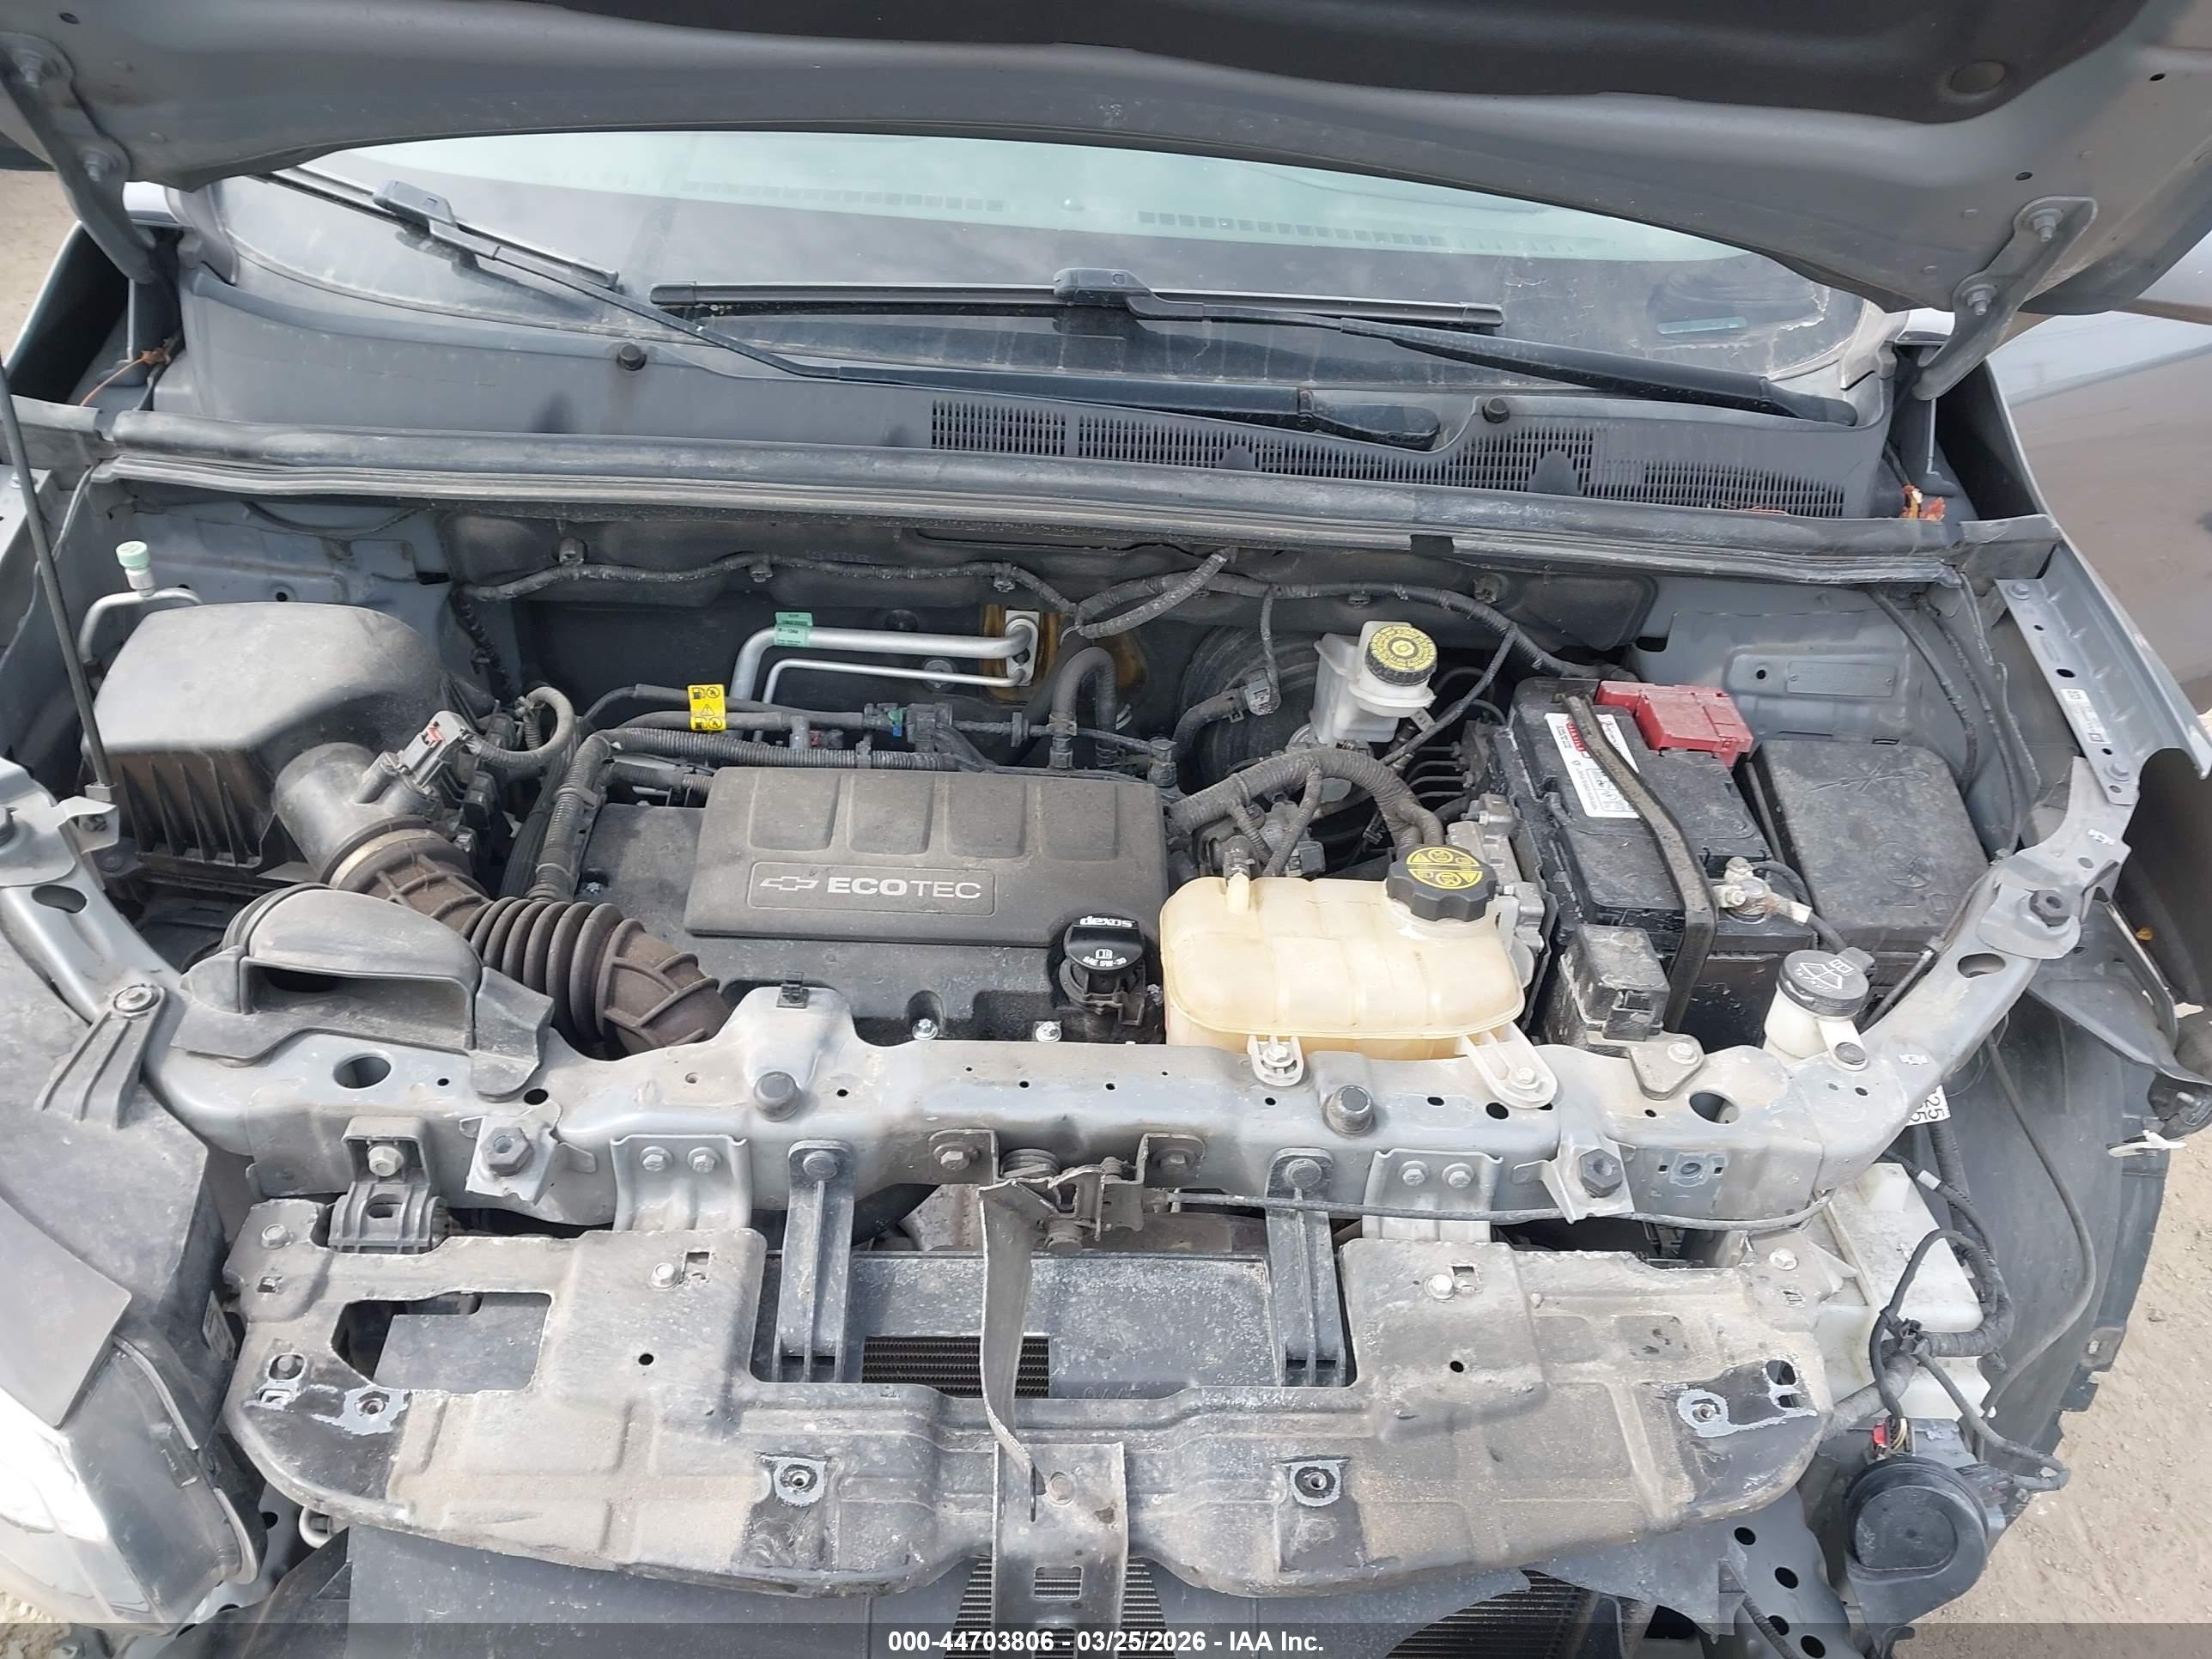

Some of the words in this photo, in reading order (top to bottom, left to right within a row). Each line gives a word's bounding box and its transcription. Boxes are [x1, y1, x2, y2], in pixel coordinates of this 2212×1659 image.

[827, 877, 981, 899] ECOTEC
[1079, 915, 1135, 927] dexos
[1923, 1096, 1945, 1119] 25
